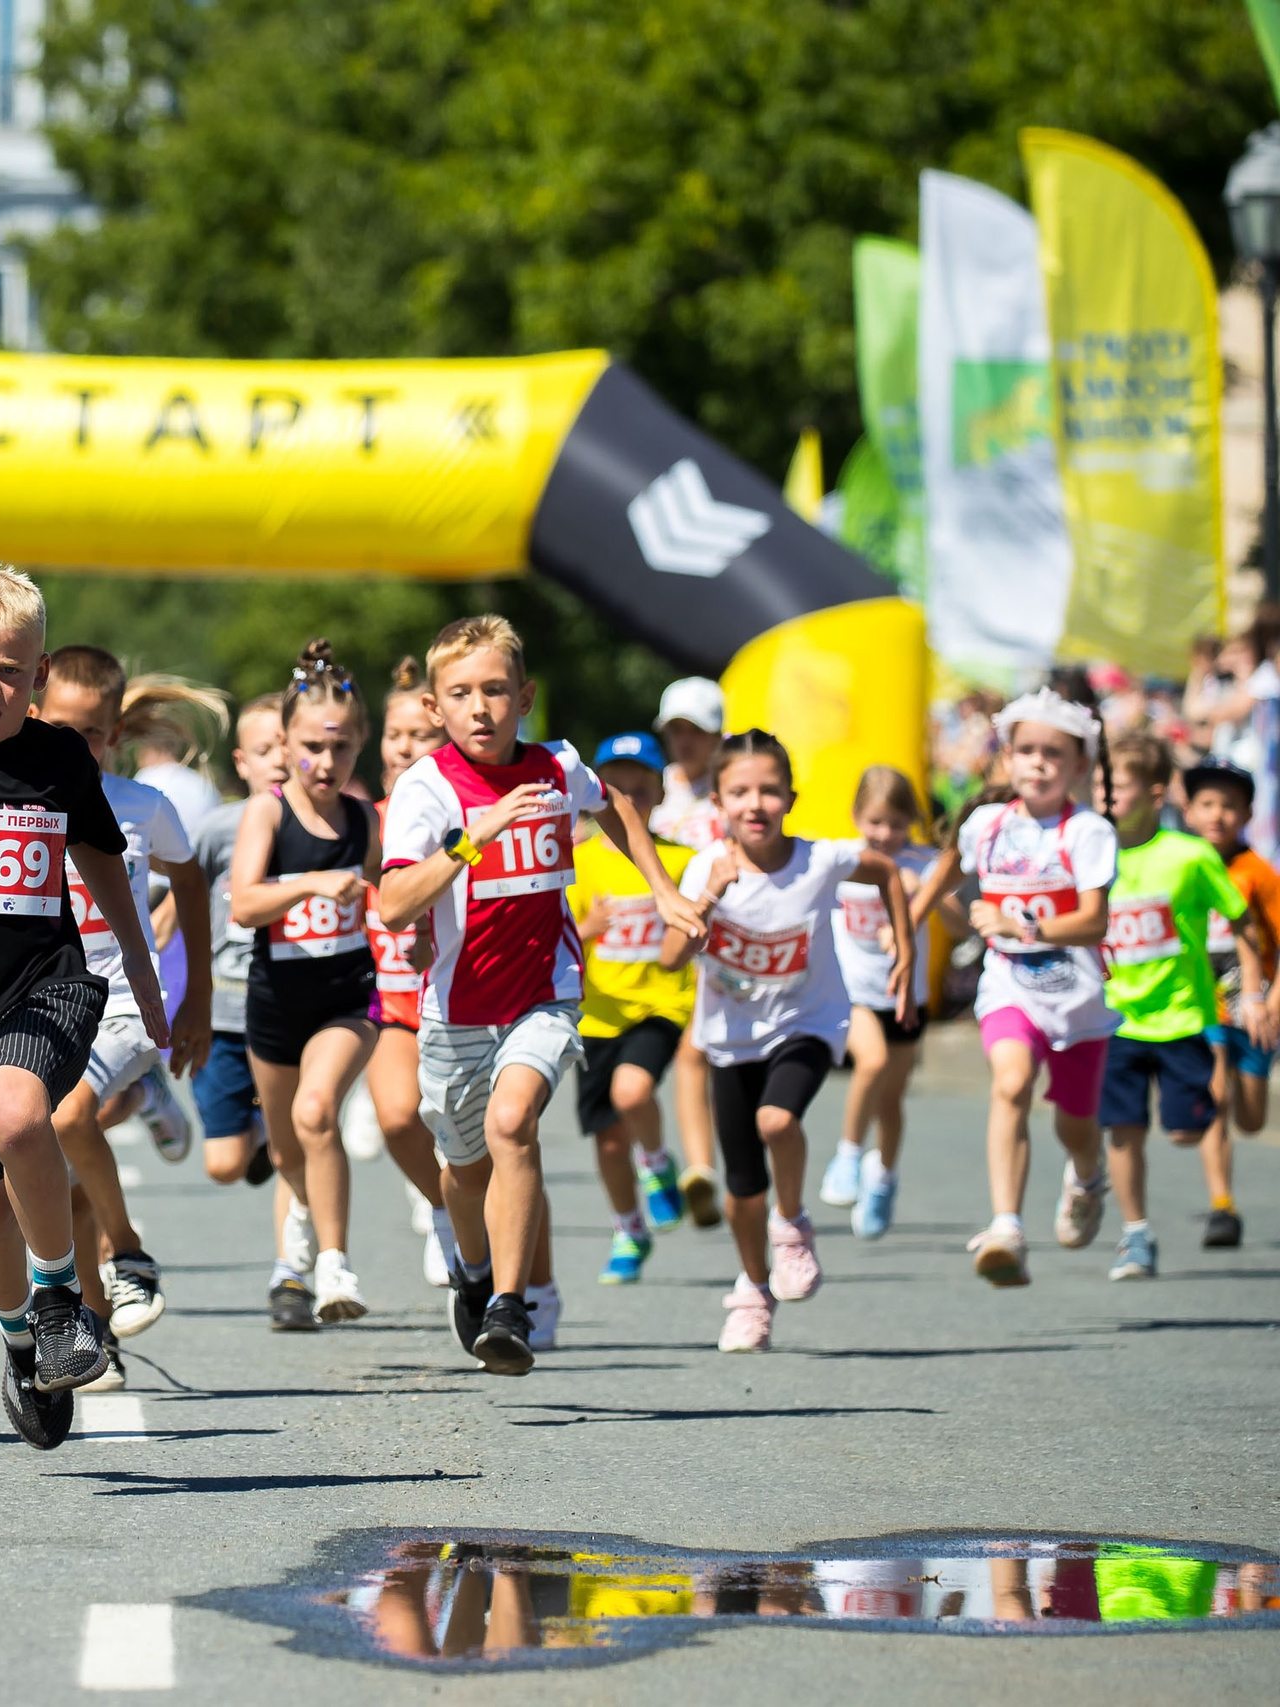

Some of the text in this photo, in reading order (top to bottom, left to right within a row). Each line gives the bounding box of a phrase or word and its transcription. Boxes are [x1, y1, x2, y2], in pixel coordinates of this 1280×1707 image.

[7, 815, 60, 829] ПЕРВЫХ
[495, 823, 560, 872] 116
[719, 931, 799, 973] 287
